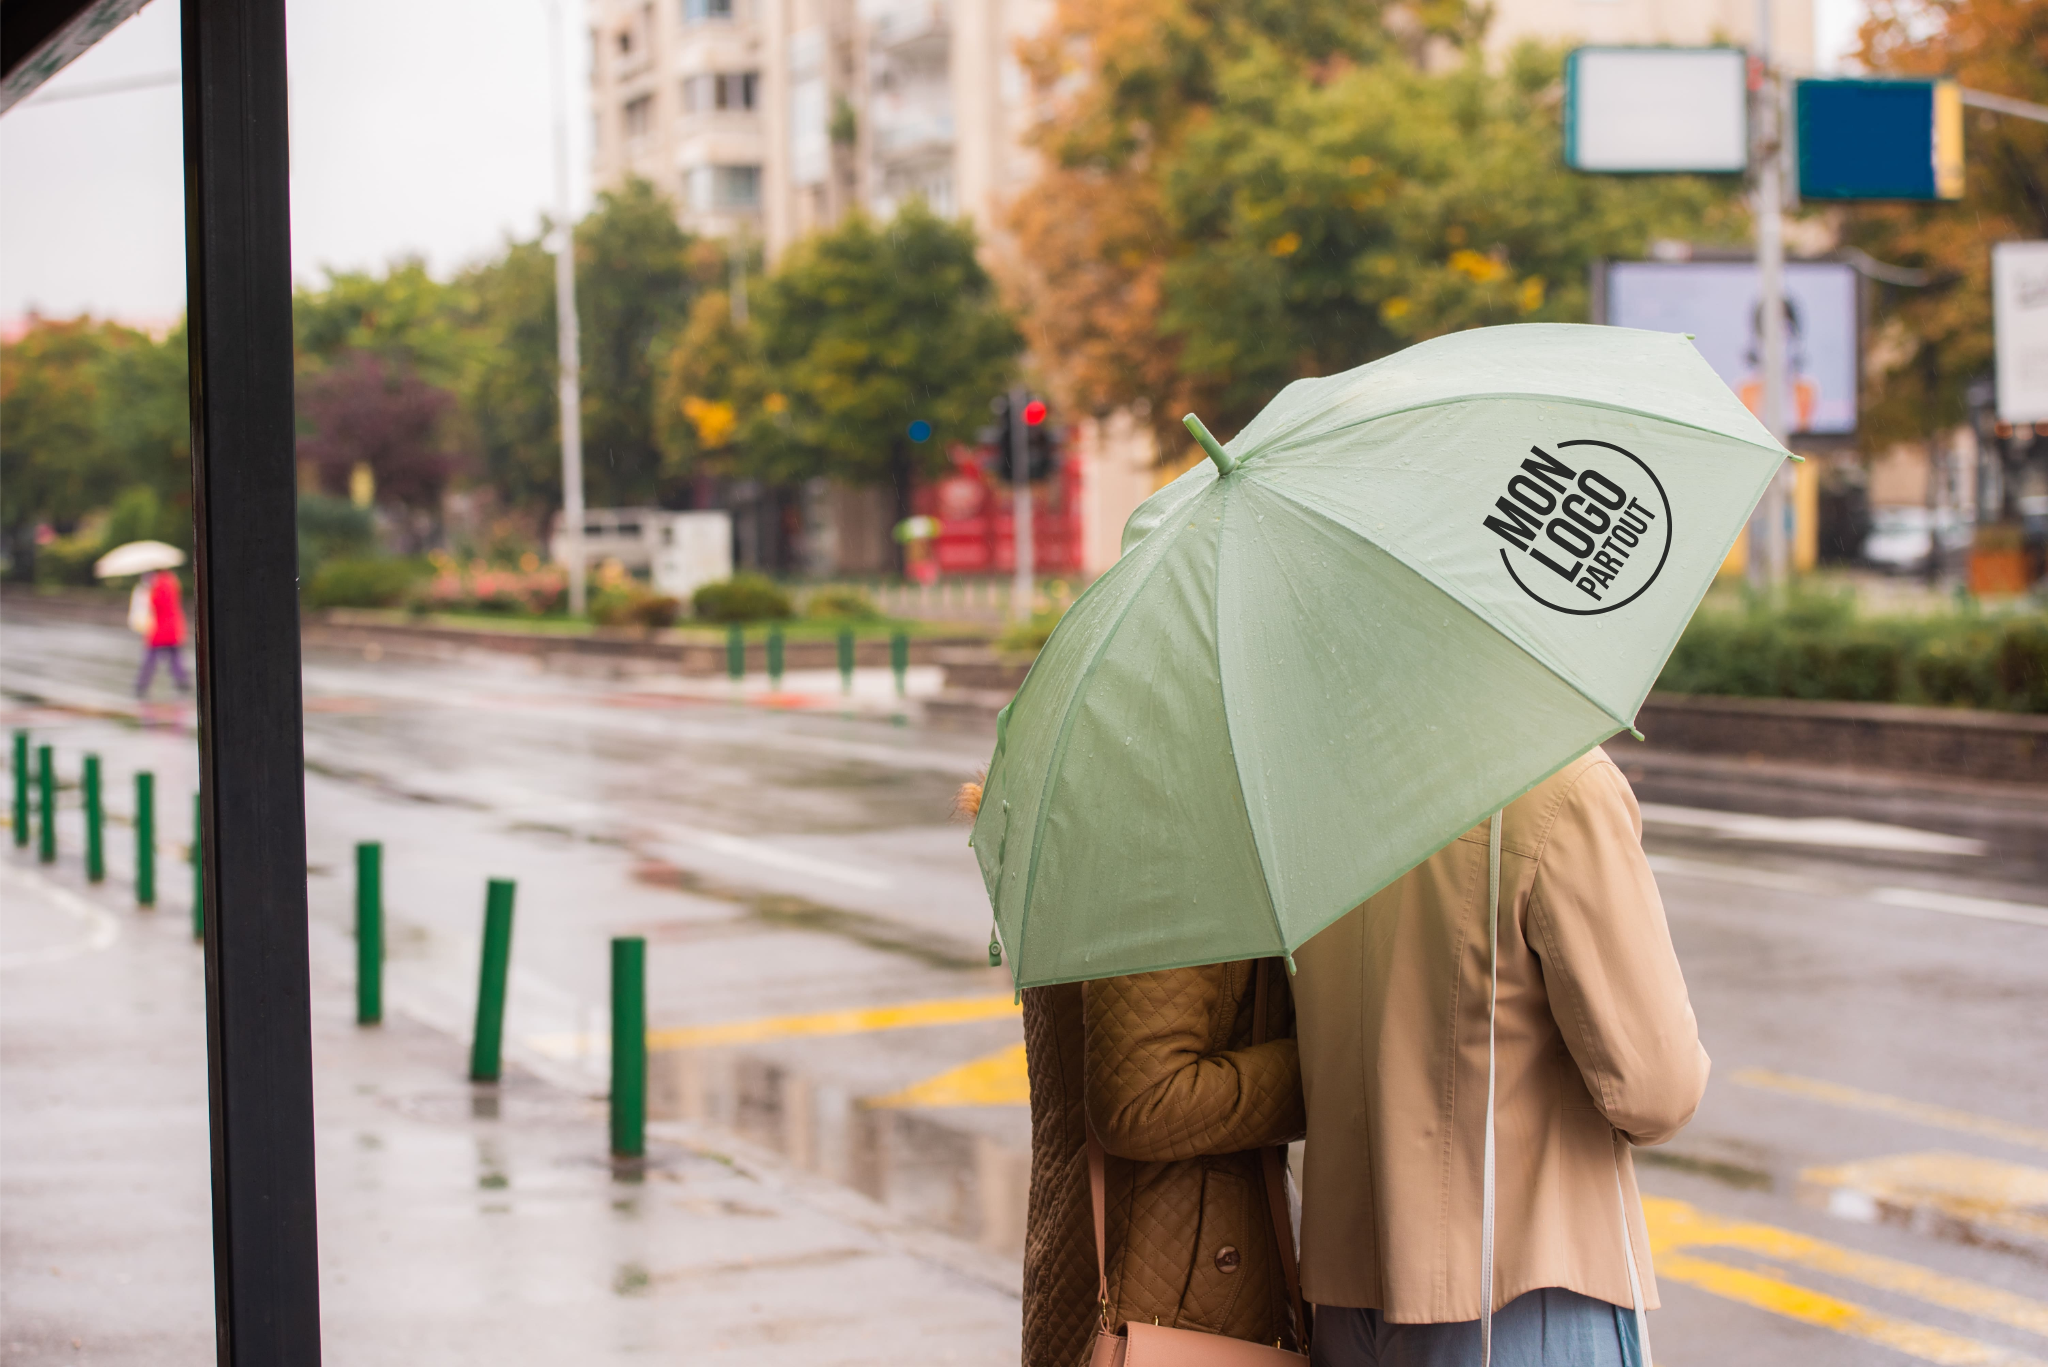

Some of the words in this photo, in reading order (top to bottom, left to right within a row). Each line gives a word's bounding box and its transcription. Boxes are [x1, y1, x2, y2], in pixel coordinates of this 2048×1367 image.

[1483, 445, 1577, 552] MON
[1529, 469, 1627, 583] LOGO
[1576, 496, 1656, 601] PARTOUT
